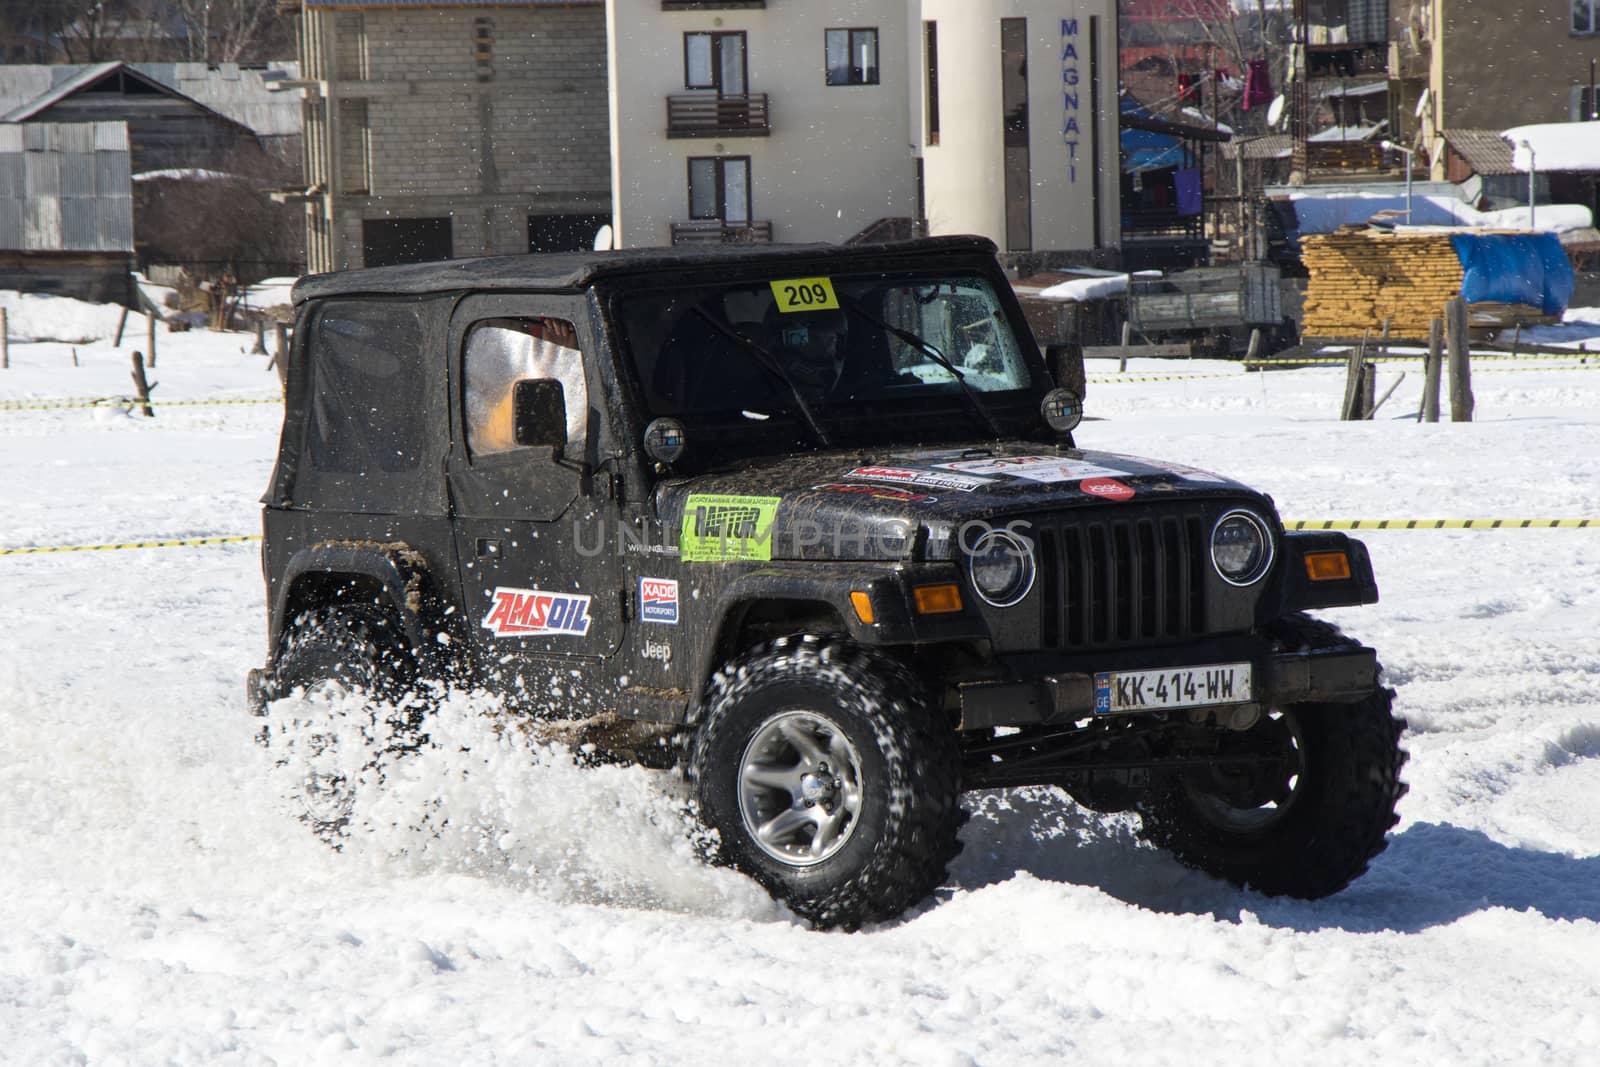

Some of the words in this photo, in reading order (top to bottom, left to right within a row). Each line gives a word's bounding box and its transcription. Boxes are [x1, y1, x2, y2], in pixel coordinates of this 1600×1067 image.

[1061, 19, 1080, 182] MAGNATI
[784, 284, 827, 305] 209
[694, 506, 760, 539] RAPTOR
[488, 592, 588, 632] AMSOIL
[644, 605, 675, 616] MOTORSPORTS
[641, 640, 670, 662] Jeep
[1116, 669, 1234, 706] KK-414-WW
[1096, 696, 1109, 709] GE
